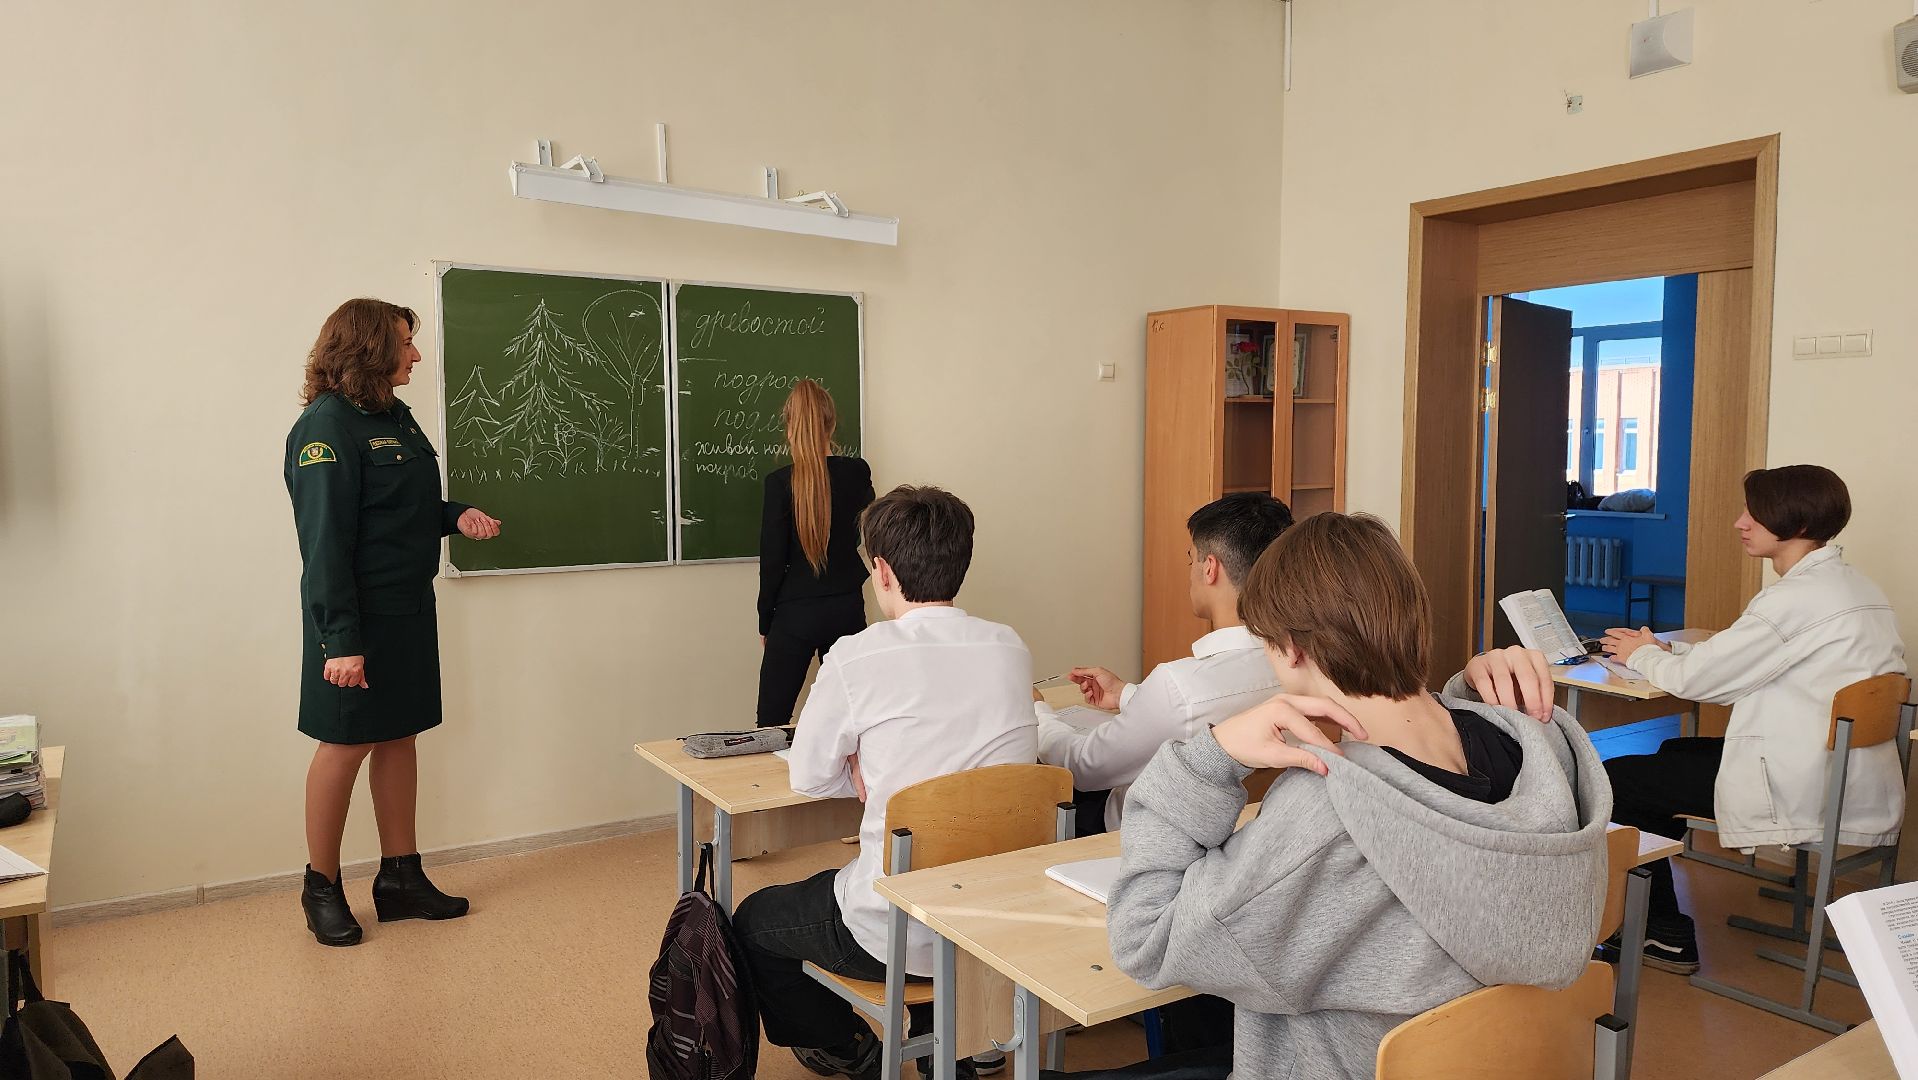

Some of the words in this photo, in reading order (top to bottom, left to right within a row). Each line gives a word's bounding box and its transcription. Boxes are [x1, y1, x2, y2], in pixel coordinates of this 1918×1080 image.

[690, 301, 825, 349] древостой
[714, 370, 831, 405] подрос
[695, 433, 759, 456] живой
